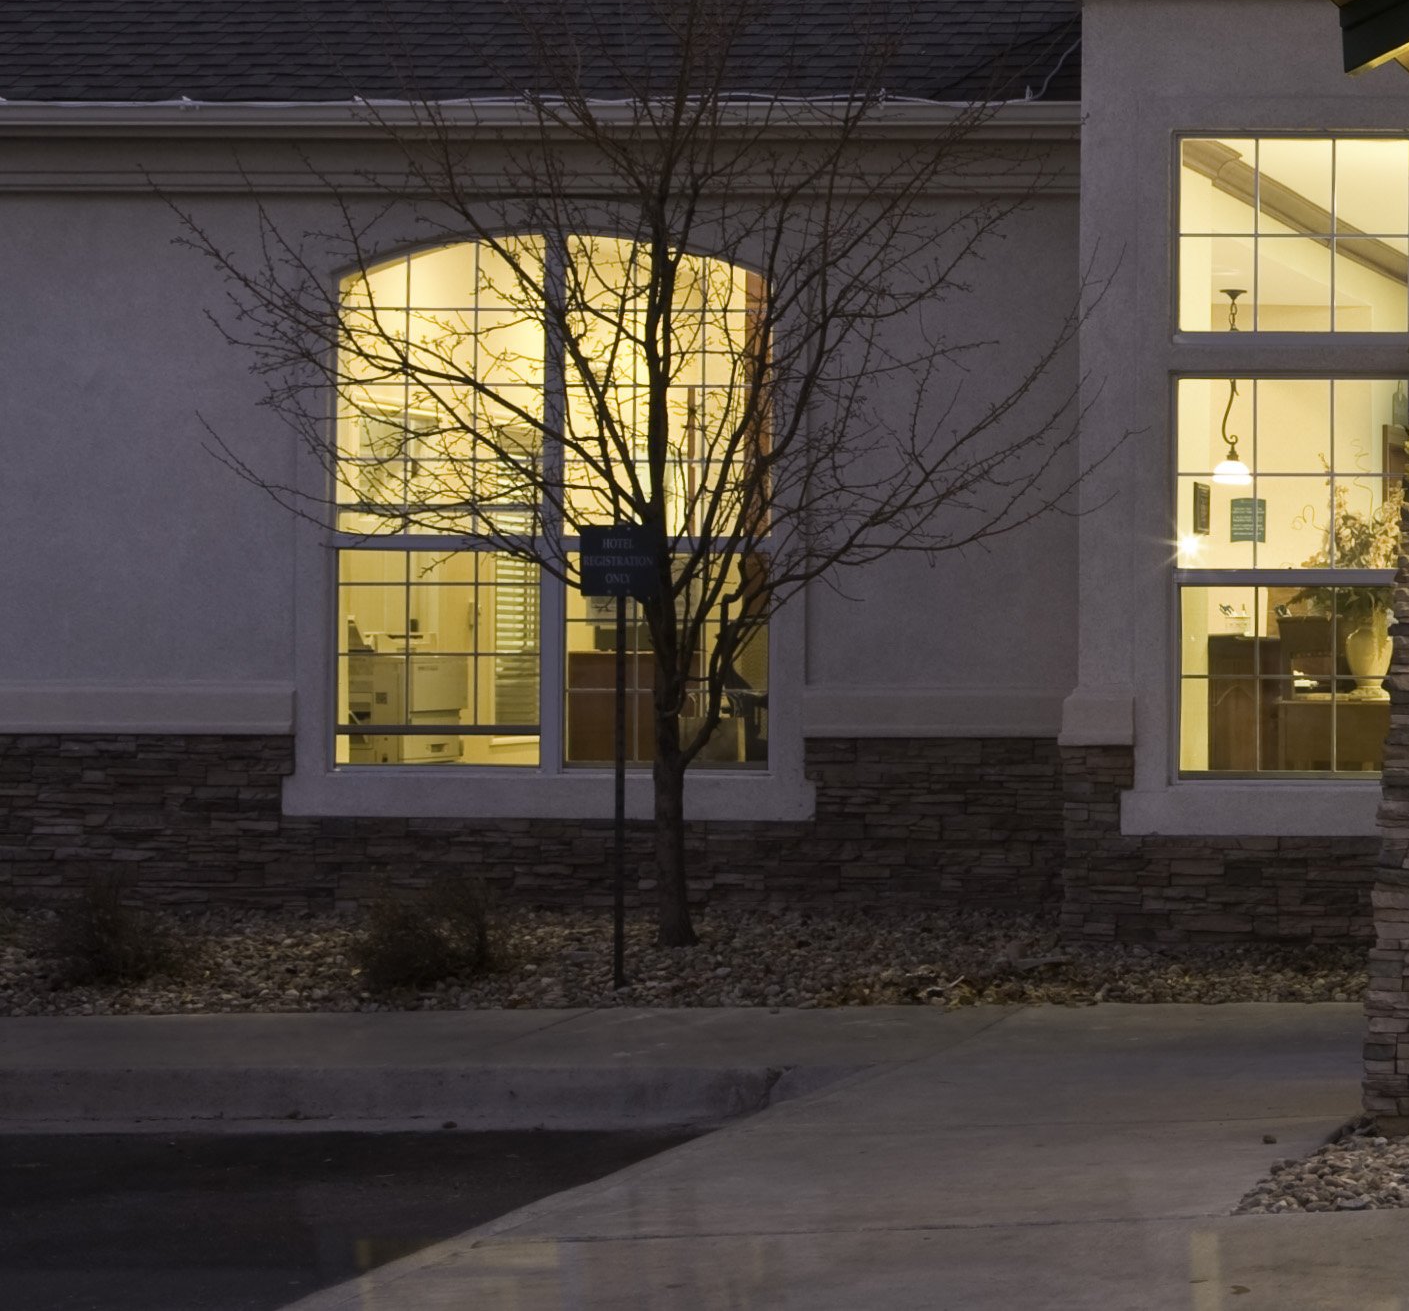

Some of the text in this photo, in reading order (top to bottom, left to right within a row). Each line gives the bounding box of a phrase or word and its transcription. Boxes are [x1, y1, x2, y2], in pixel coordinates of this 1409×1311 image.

[602, 538, 634, 549] HOTEL
[583, 555, 653, 567] REGISTRATION
[604, 573, 631, 584] ONLY
